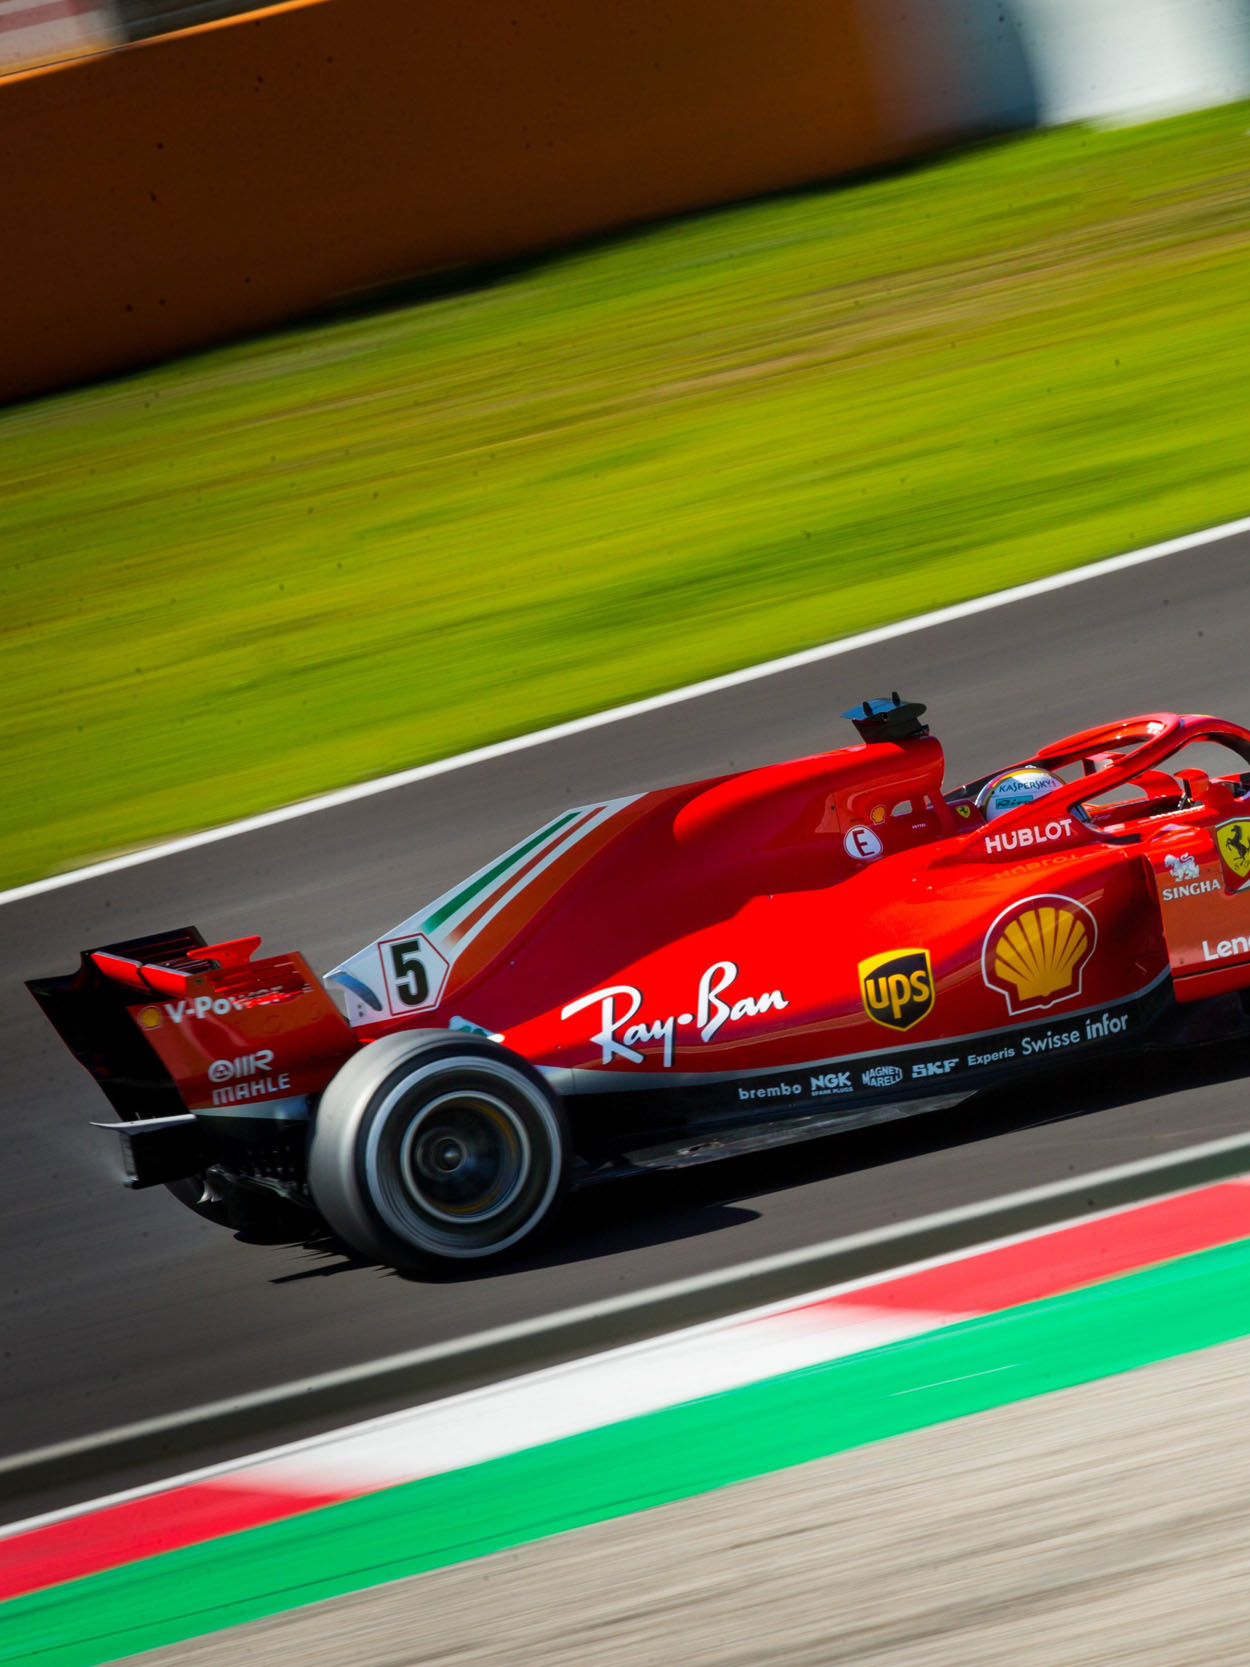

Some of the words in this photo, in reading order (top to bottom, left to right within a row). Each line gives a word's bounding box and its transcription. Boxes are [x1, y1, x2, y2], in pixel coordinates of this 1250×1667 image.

[999, 780, 1050, 793] KASPERSKY
[852, 829, 875, 857] E
[985, 818, 1073, 854] HUBLOT
[1162, 879, 1222, 901] SINGHA
[389, 938, 430, 1006] 5
[1085, 1012, 1129, 1040] infor
[1021, 1031, 1081, 1056] Swisse
[967, 1047, 1016, 1066] Experis
[911, 1058, 960, 1079] SKF
[212, 1073, 292, 1105] MAHLE
[738, 1083, 803, 1101] brembo
[810, 1071, 852, 1091] NGK
